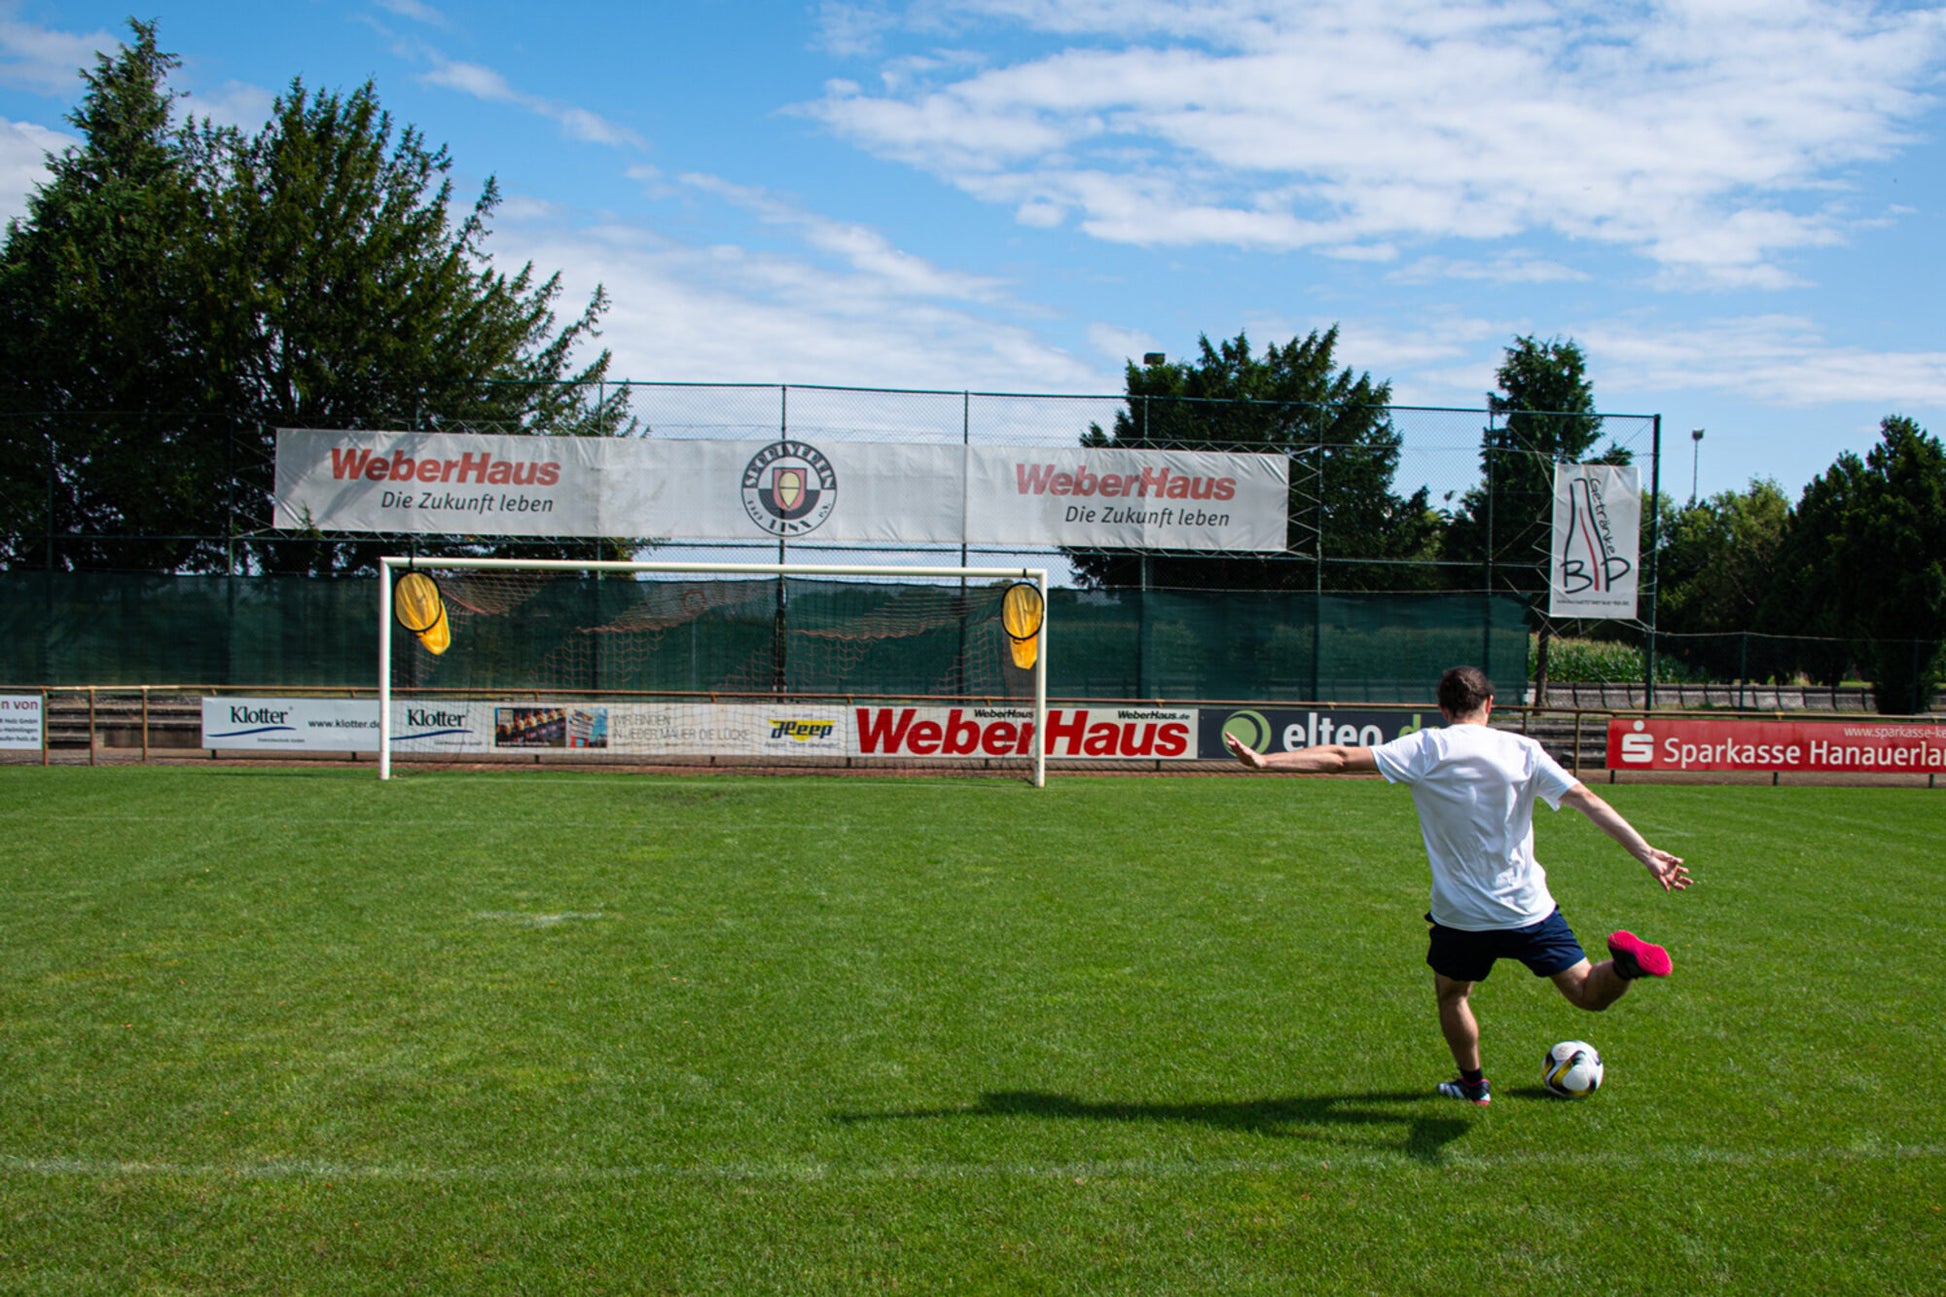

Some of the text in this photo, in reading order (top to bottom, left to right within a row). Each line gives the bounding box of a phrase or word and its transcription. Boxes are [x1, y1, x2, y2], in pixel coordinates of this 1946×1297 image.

[331, 447, 561, 486] WeberHaus
[1016, 463, 1238, 501] WeberHaus
[381, 491, 553, 514] Die Zukunft leben
[1065, 506, 1230, 528] Die Zukunft leben
[13, 700, 38, 710] von
[230, 705, 288, 724] Klotter
[1118, 710, 1191, 720] WeberHaus.de
[407, 708, 466, 727] Klotter
[855, 707, 1190, 757] WeberHaus
[1663, 738, 1800, 769] Sparkasse
